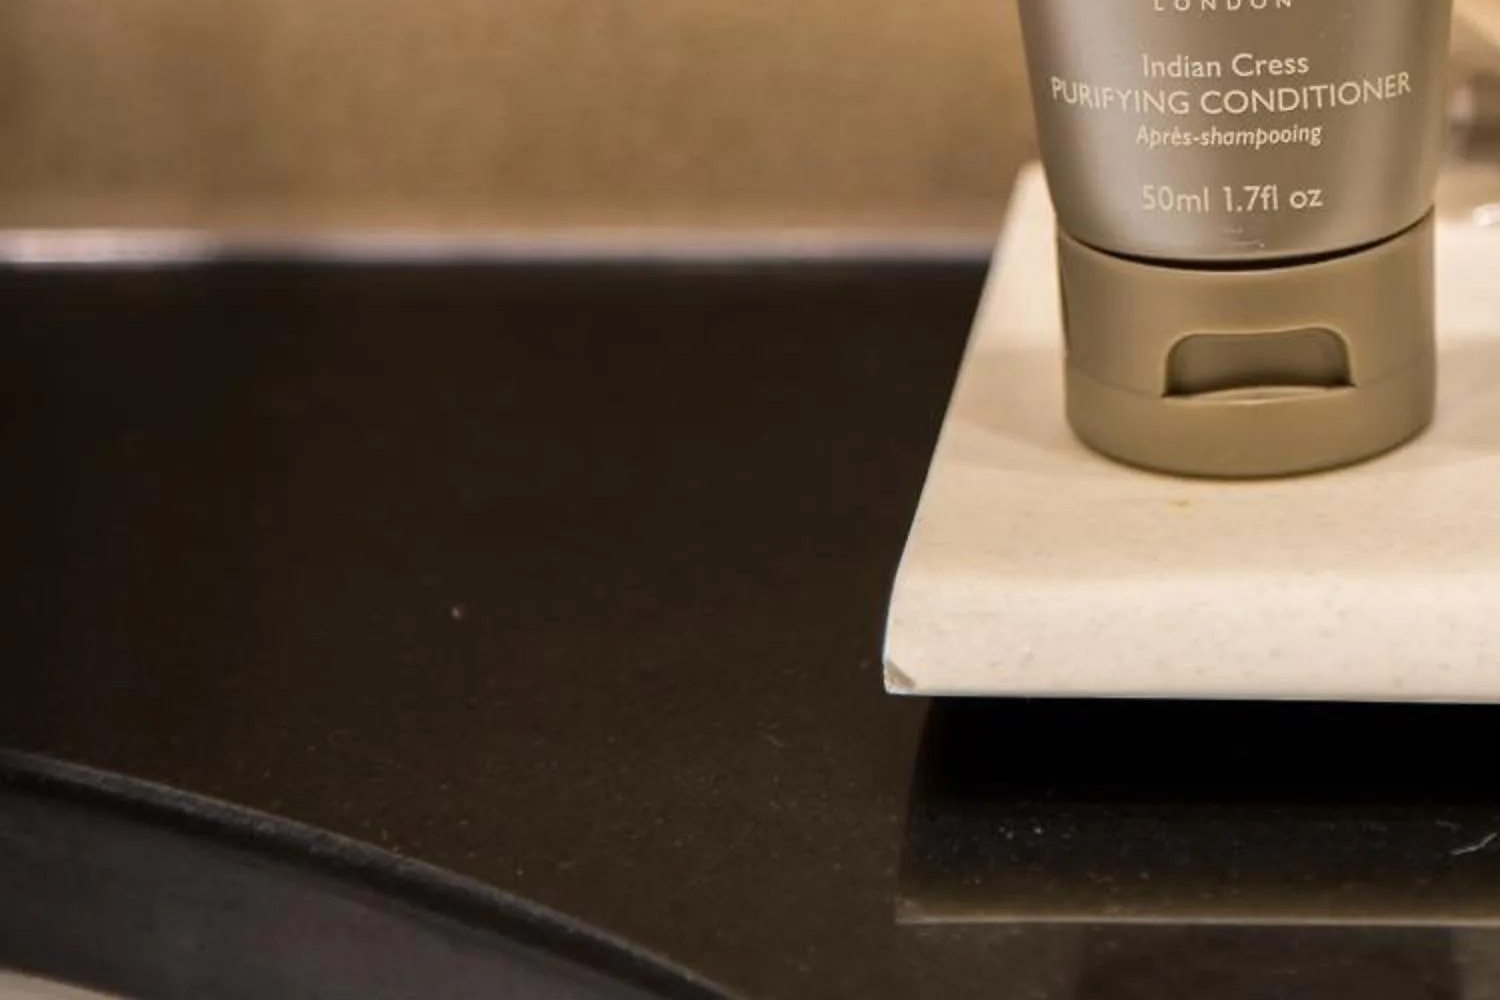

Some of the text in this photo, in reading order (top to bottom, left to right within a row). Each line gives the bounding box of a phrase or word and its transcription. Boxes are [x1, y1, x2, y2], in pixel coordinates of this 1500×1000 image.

[1142, 53, 1309, 79] Indian Cress
[1051, 71, 1411, 115] PURIFYING CONDITIONER
[1142, 186, 1323, 213] 50ml 1.7fl oz
